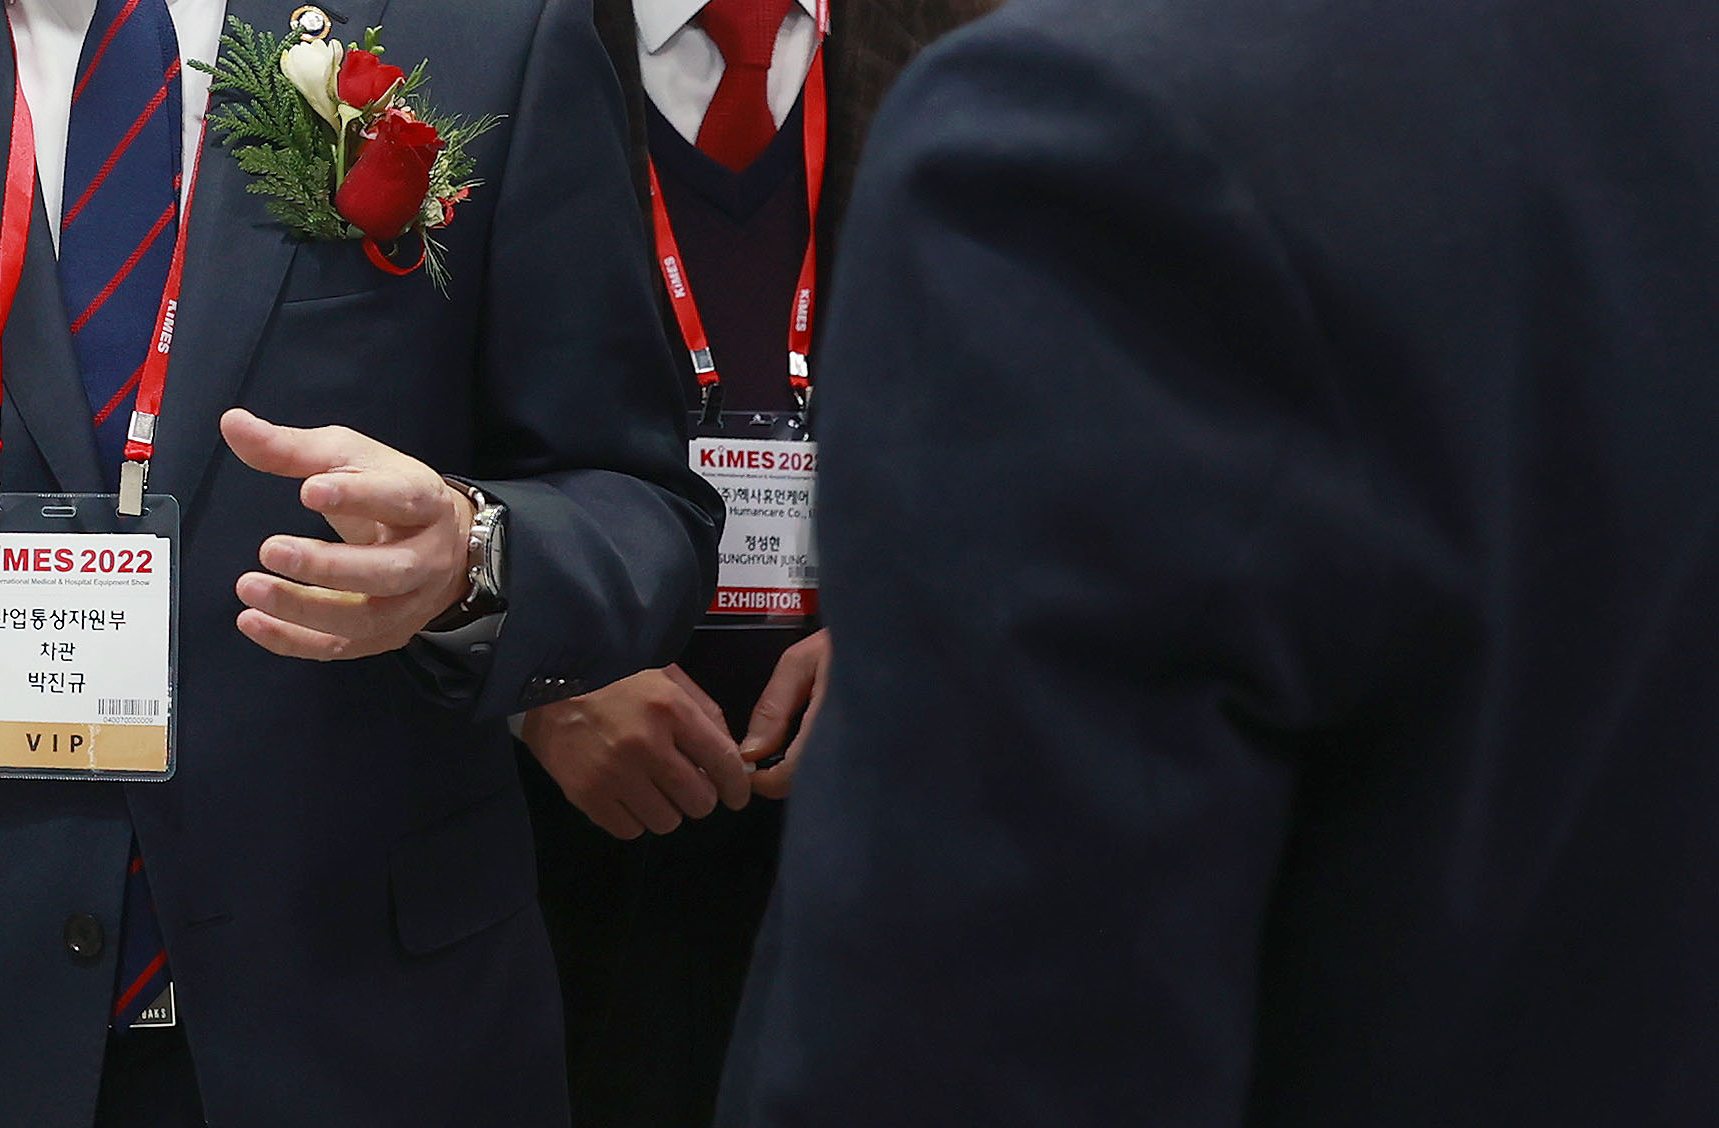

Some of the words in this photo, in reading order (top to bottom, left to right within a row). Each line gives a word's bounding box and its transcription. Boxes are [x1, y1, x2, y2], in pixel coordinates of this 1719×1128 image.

[779, 452, 819, 472] 202
[728, 506, 785, 519] Humancare
[745, 535, 781, 553] 정성현
[80, 548, 153, 574] 2022
[780, 553, 809, 568] JUNG
[31, 577, 57, 586] Medical
[58, 578, 63, 586] &
[64, 578, 92, 587] Hospital
[93, 578, 130, 588] Equipment
[131, 578, 150, 587] Show
[717, 591, 802, 609] EXHIBITOR
[40, 642, 76, 662] 차관
[28, 672, 86, 694] 박진규
